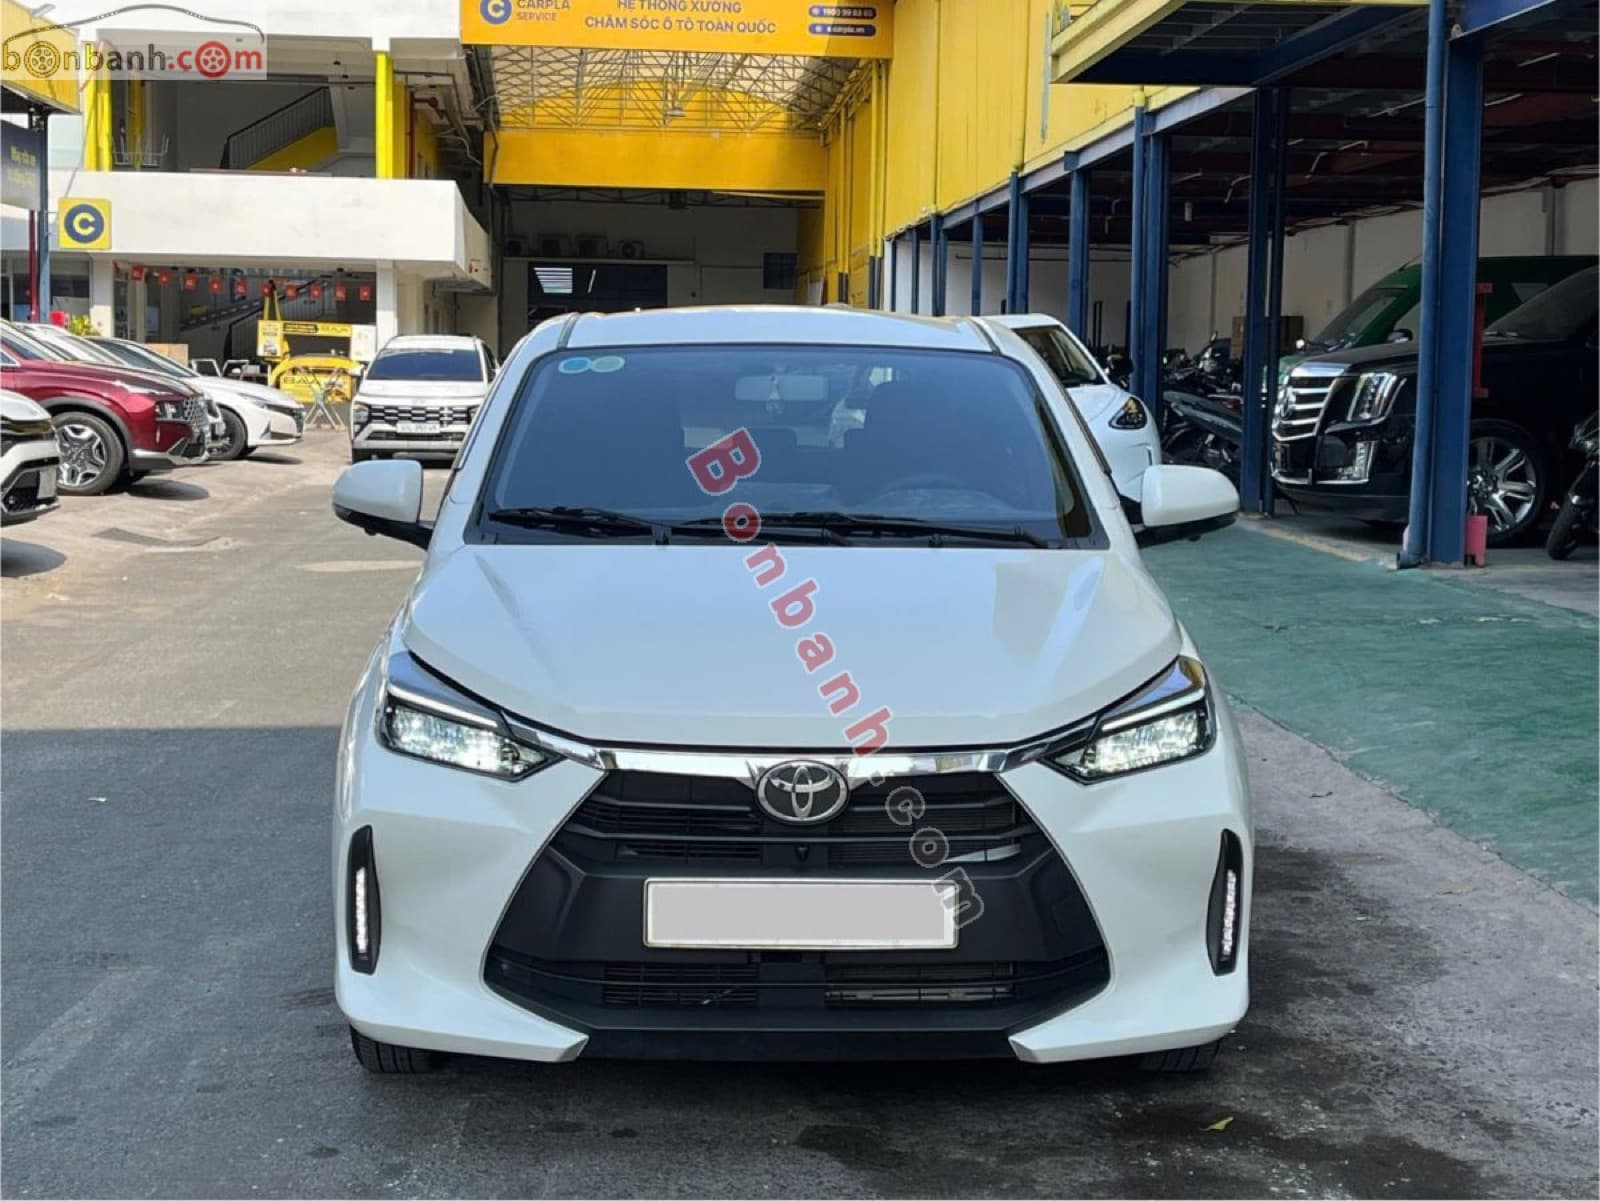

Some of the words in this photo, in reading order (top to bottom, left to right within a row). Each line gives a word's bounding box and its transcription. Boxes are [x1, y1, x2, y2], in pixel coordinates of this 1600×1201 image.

[516, 0, 570, 10] CARPLA
[516, 11, 558, 21] SERVICE
[584, 14, 628, 29] CHĂM
[630, 15, 660, 30] SÓC
[663, 16, 673, 31] Ô
[675, 17, 694, 31] TÔ
[696, 17, 734, 32] TOÀN
[737, 18, 777, 33] QUỐC
